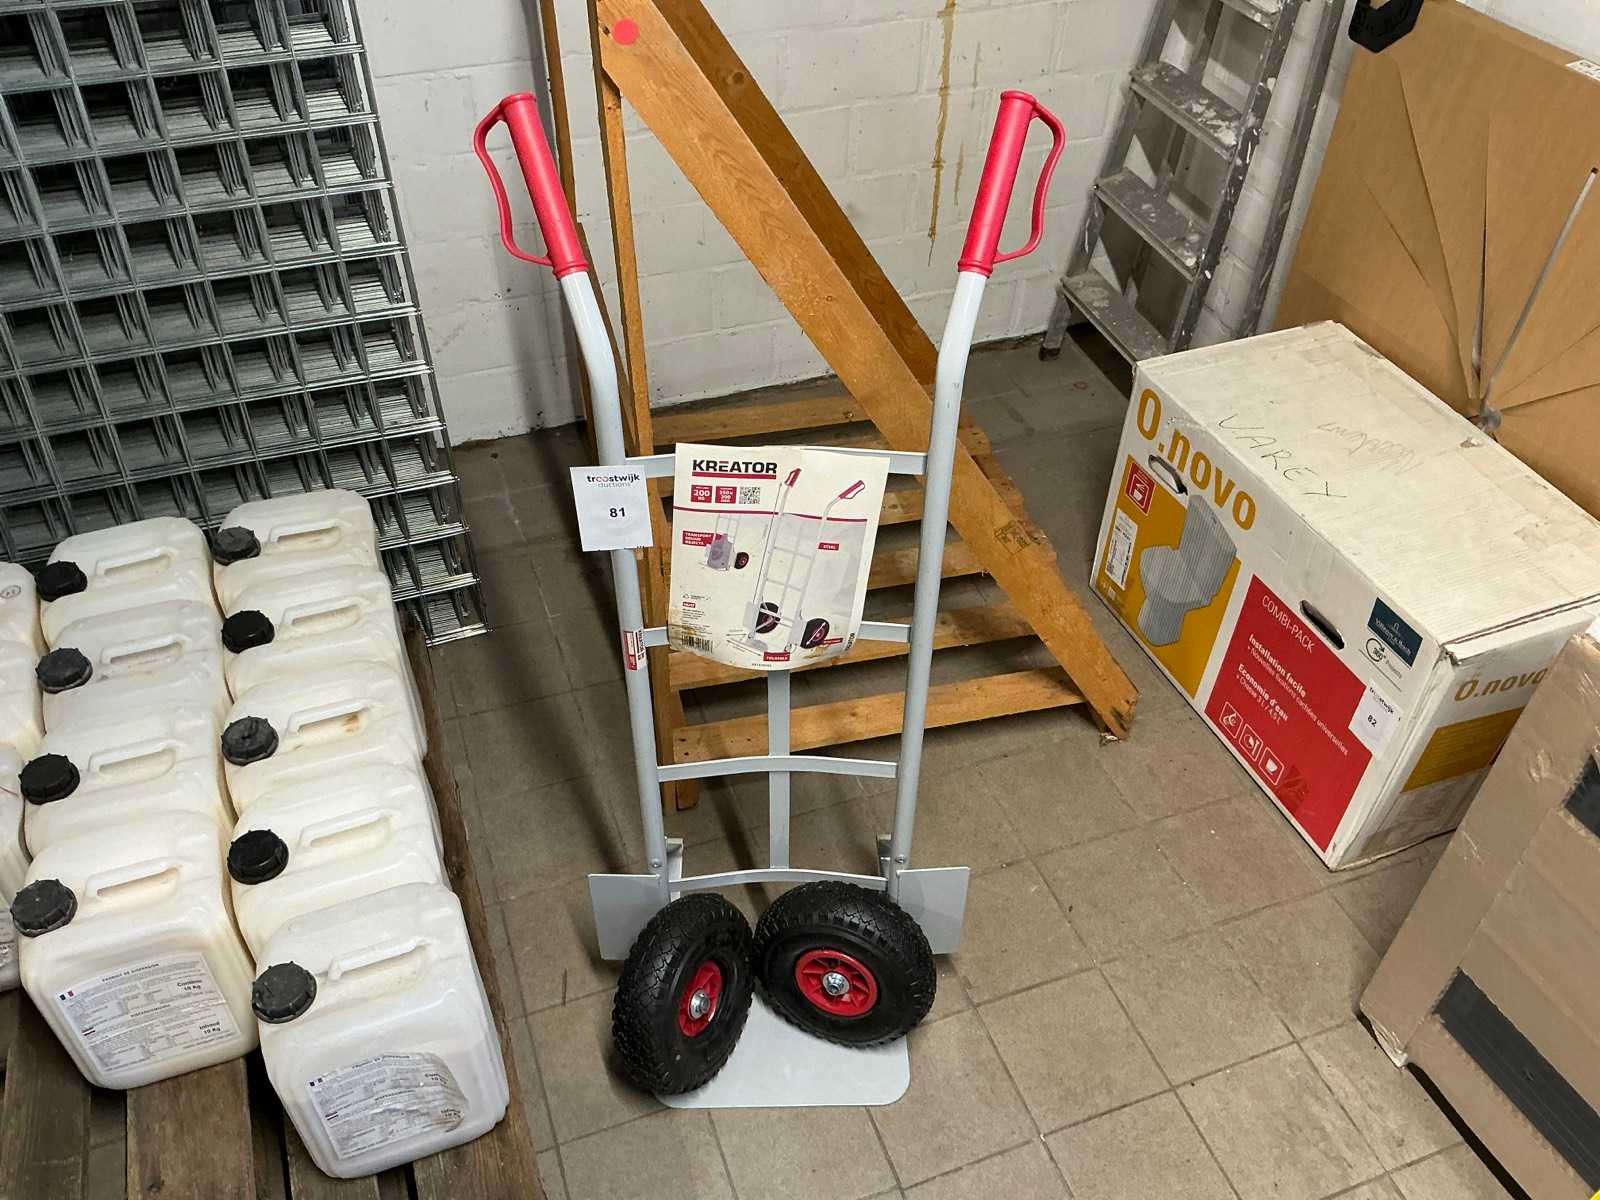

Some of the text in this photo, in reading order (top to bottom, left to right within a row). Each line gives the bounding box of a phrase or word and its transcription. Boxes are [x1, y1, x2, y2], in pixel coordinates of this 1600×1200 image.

[692, 459, 777, 474] KREATOR
[1136, 388, 1256, 531] O.novo
[587, 473, 640, 483] troostwijk
[609, 507, 626, 518] 81
[1262, 595, 1316, 654] COMBI-PACK
[1248, 634, 1307, 698] Installation facile
[1455, 667, 1548, 702] O.novo
[1367, 714, 1378, 728] 82
